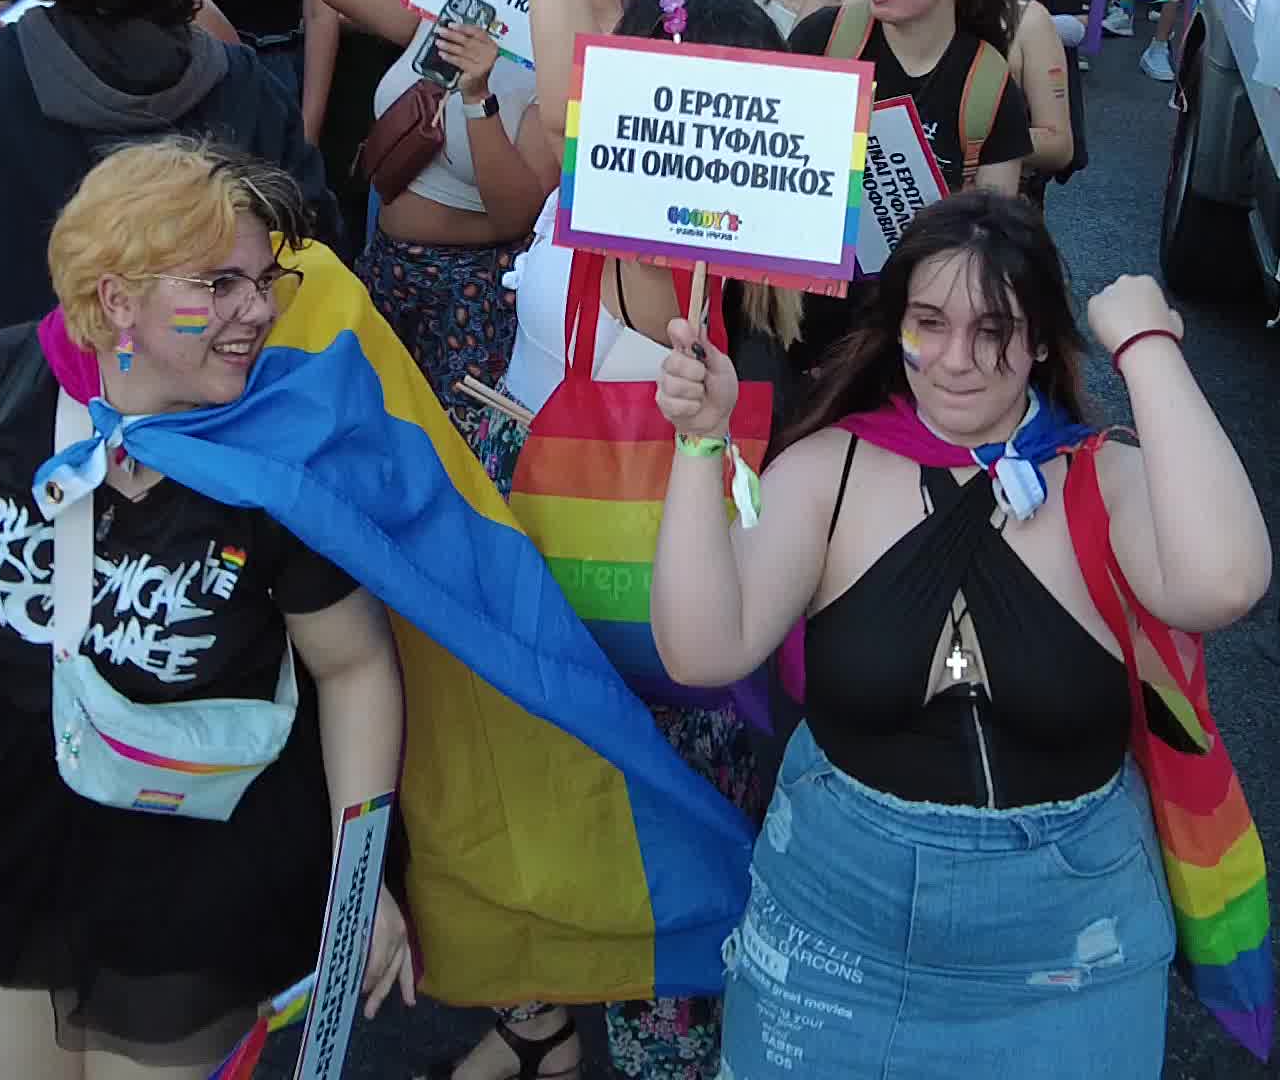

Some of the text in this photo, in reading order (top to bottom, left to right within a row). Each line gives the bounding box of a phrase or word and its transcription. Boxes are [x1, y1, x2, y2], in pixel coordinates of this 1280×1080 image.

[653, 87, 782, 125] Ο ΕΡΩΤΑΣ
[616, 115, 811, 167] ΕΙΝΑΙ ΤΥΦΛΟΣ,
[590, 144, 836, 197] ΟΧΙ ΟΜΟΦΟΒΙΚΟΣ
